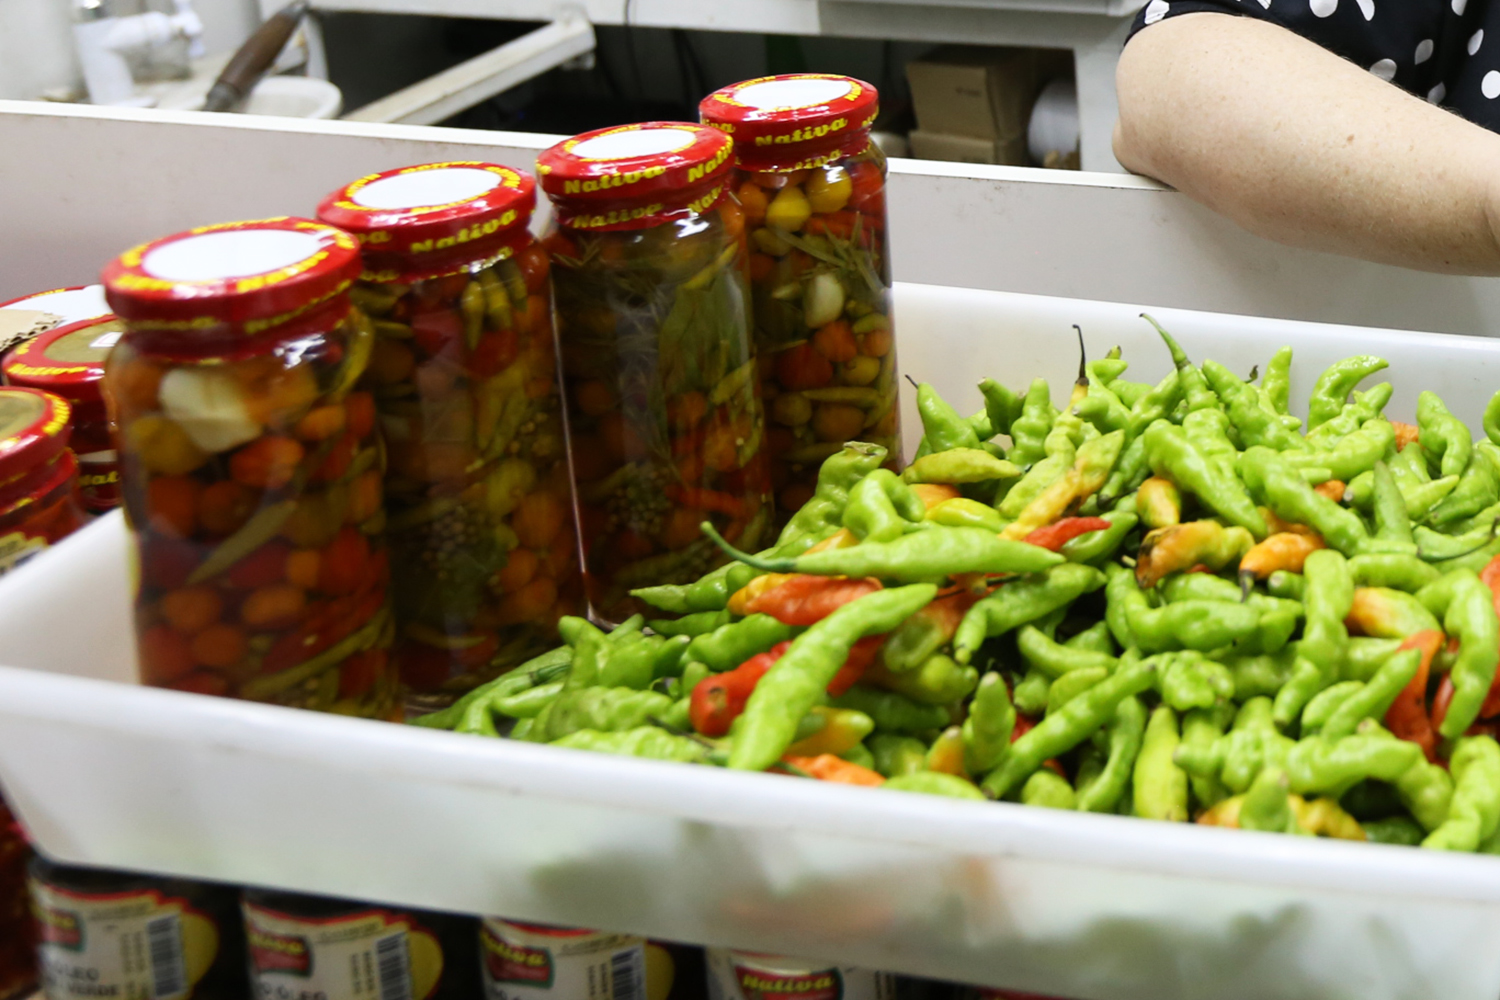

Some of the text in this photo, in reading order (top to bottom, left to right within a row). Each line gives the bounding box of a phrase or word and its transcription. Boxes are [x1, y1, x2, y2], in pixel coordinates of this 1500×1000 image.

[754, 115, 849, 148] Nativa
[563, 164, 668, 195] Nativa
[408, 208, 519, 254] Nativa
[572, 201, 666, 229] Nativa
